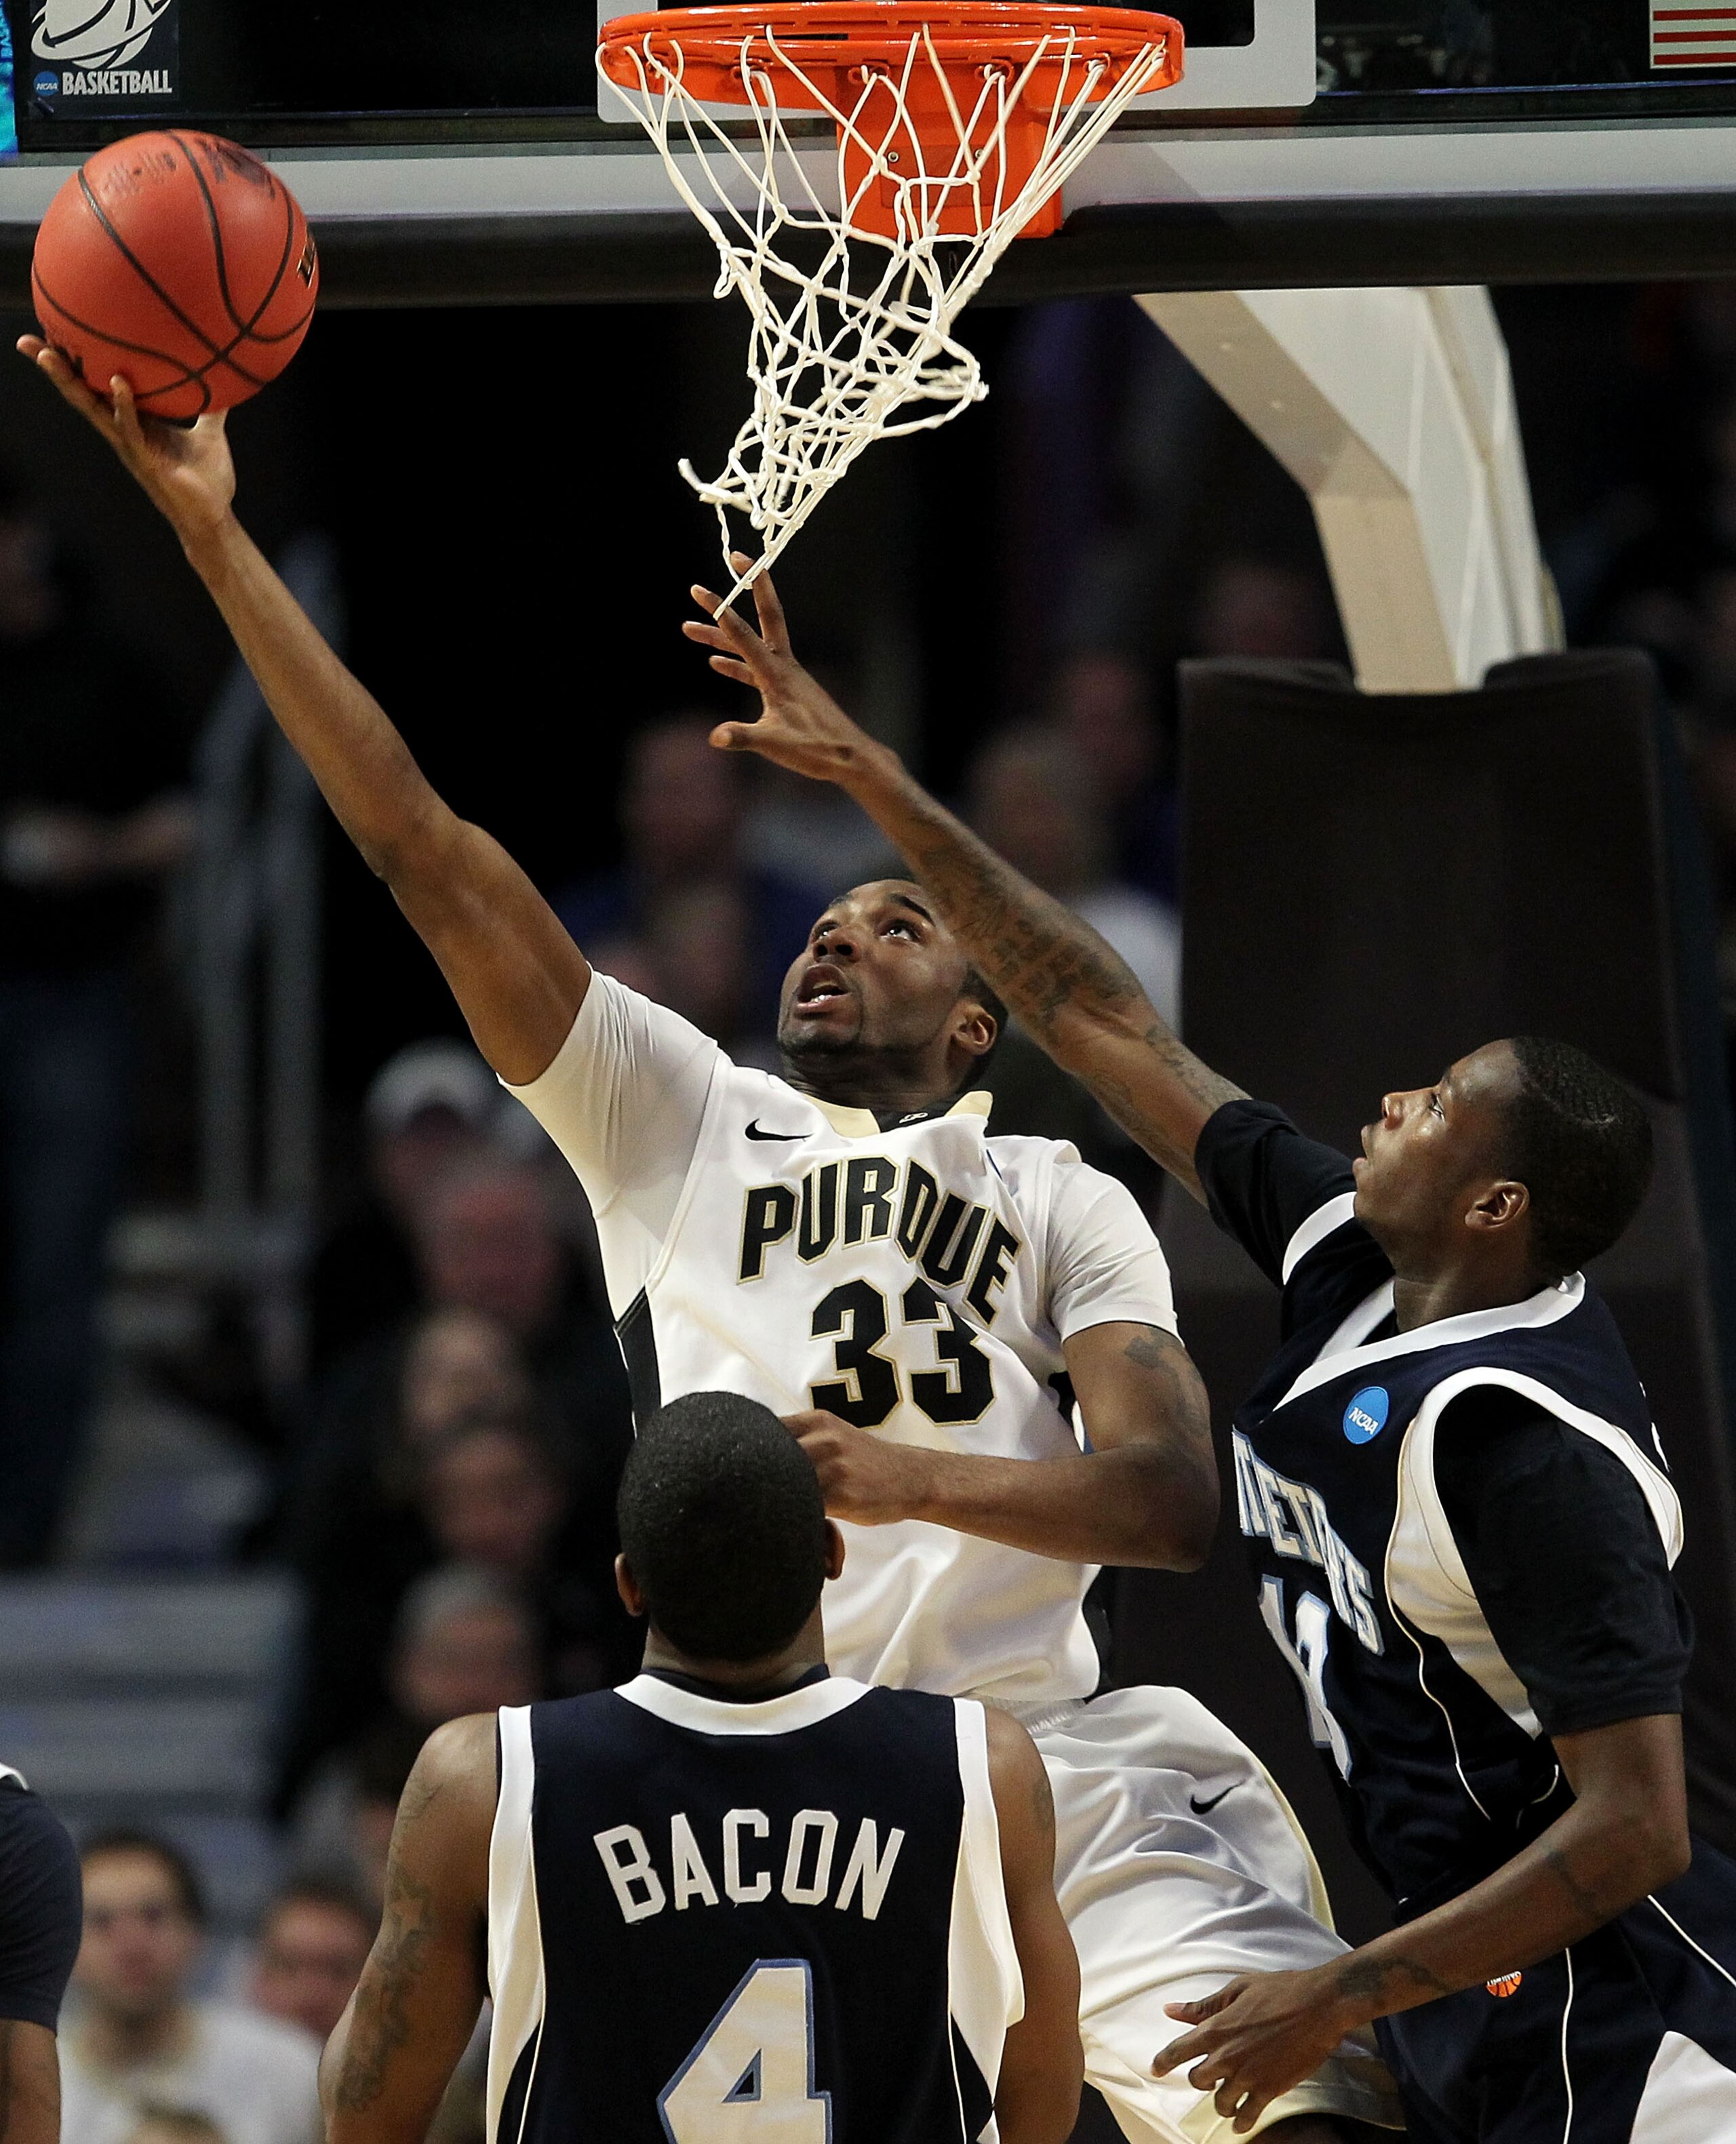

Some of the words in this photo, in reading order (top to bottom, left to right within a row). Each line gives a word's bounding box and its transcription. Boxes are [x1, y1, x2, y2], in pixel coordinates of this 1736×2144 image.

[36, 82, 58, 91] NCAA
[62, 70, 172, 95] BASKETBALL
[736, 1154, 1022, 1330] PURDUE
[808, 1275, 997, 1429] 33
[1348, 1406, 1379, 1435] NCAA
[593, 1808, 905, 1924] BACON
[656, 1958, 833, 2144] 4
